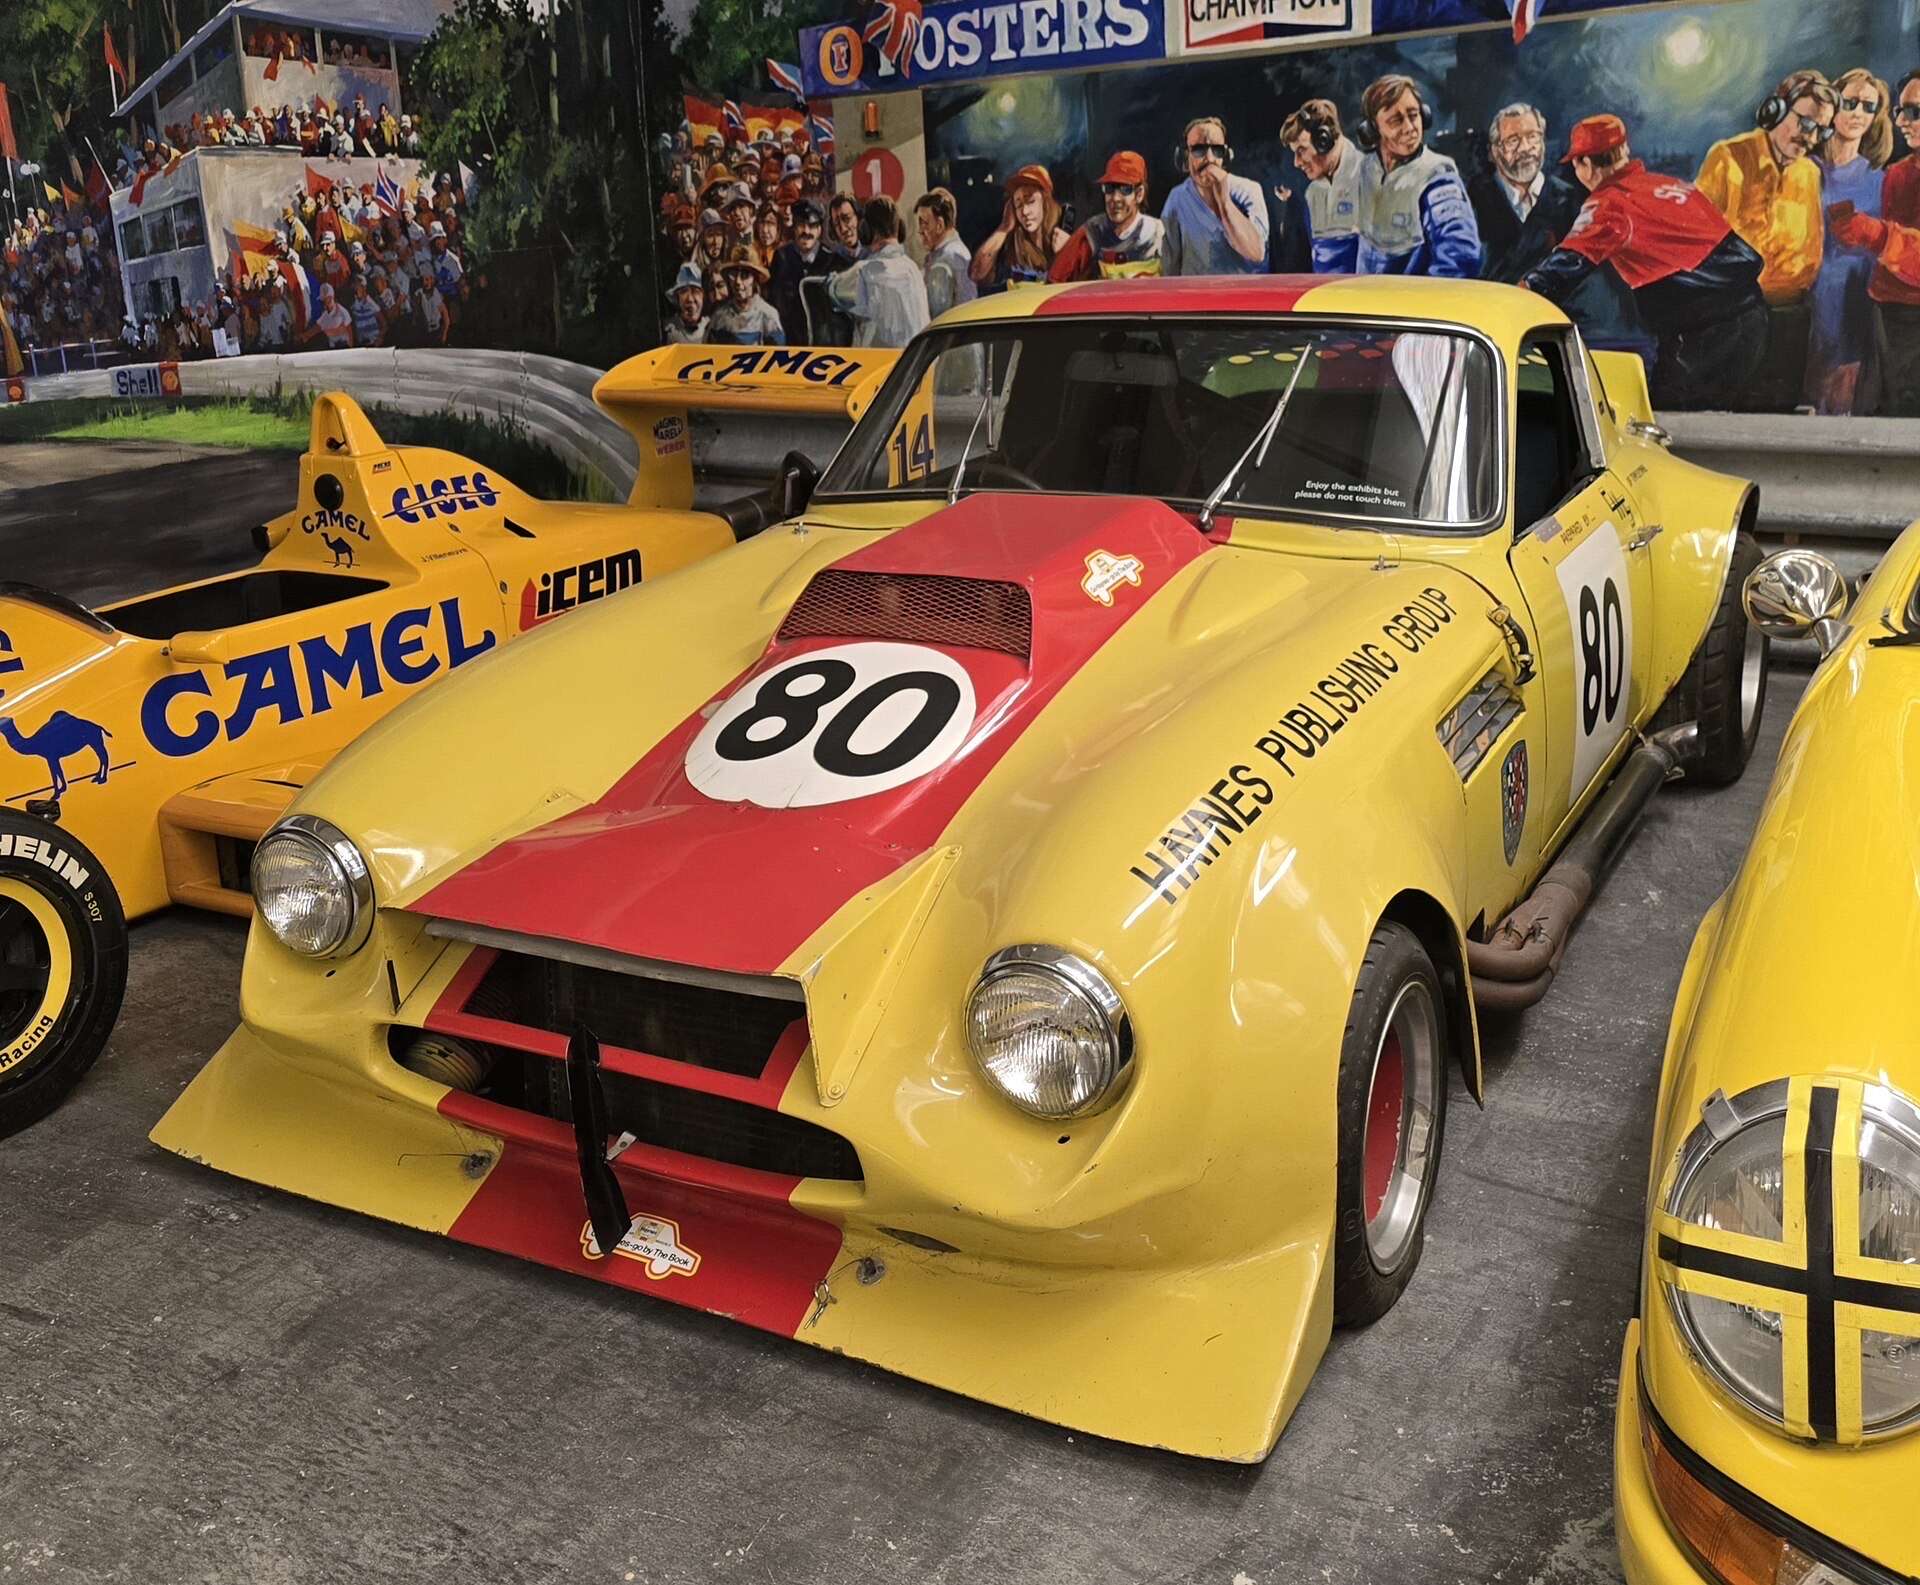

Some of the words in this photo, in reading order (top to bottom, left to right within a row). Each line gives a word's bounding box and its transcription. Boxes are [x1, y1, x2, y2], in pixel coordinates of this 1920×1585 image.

[878, 0, 1150, 77] OSTERS
[117, 368, 160, 396] Shell
[892, 413, 935, 482] 14
[1294, 490, 1322, 499] please
[1324, 491, 1336, 500] do
[1338, 493, 1353, 501] not
[1355, 496, 1381, 504] touch
[1382, 498, 1406, 508] them
[1306, 480, 1330, 491] Enjoy
[1331, 482, 1346, 491] the
[1348, 484, 1381, 495] exhibits
[1384, 487, 1400, 497] but
[302, 510, 370, 541] CAMEL
[140, 597, 497, 758] CAMEL
[1579, 576, 1624, 737] 80
[715, 659, 961, 777] 80
[1129, 764, 1274, 906] HAYNES
[1253, 642, 1399, 778] PUBLISHING
[1382, 586, 1458, 654] GROUP
[84, 891, 103, 923] S307
[0, 1014, 54, 1068] Racing
[643, 1244, 654, 1256] by
[654, 1248, 668, 1259] The
[668, 1253, 690, 1266] Book
